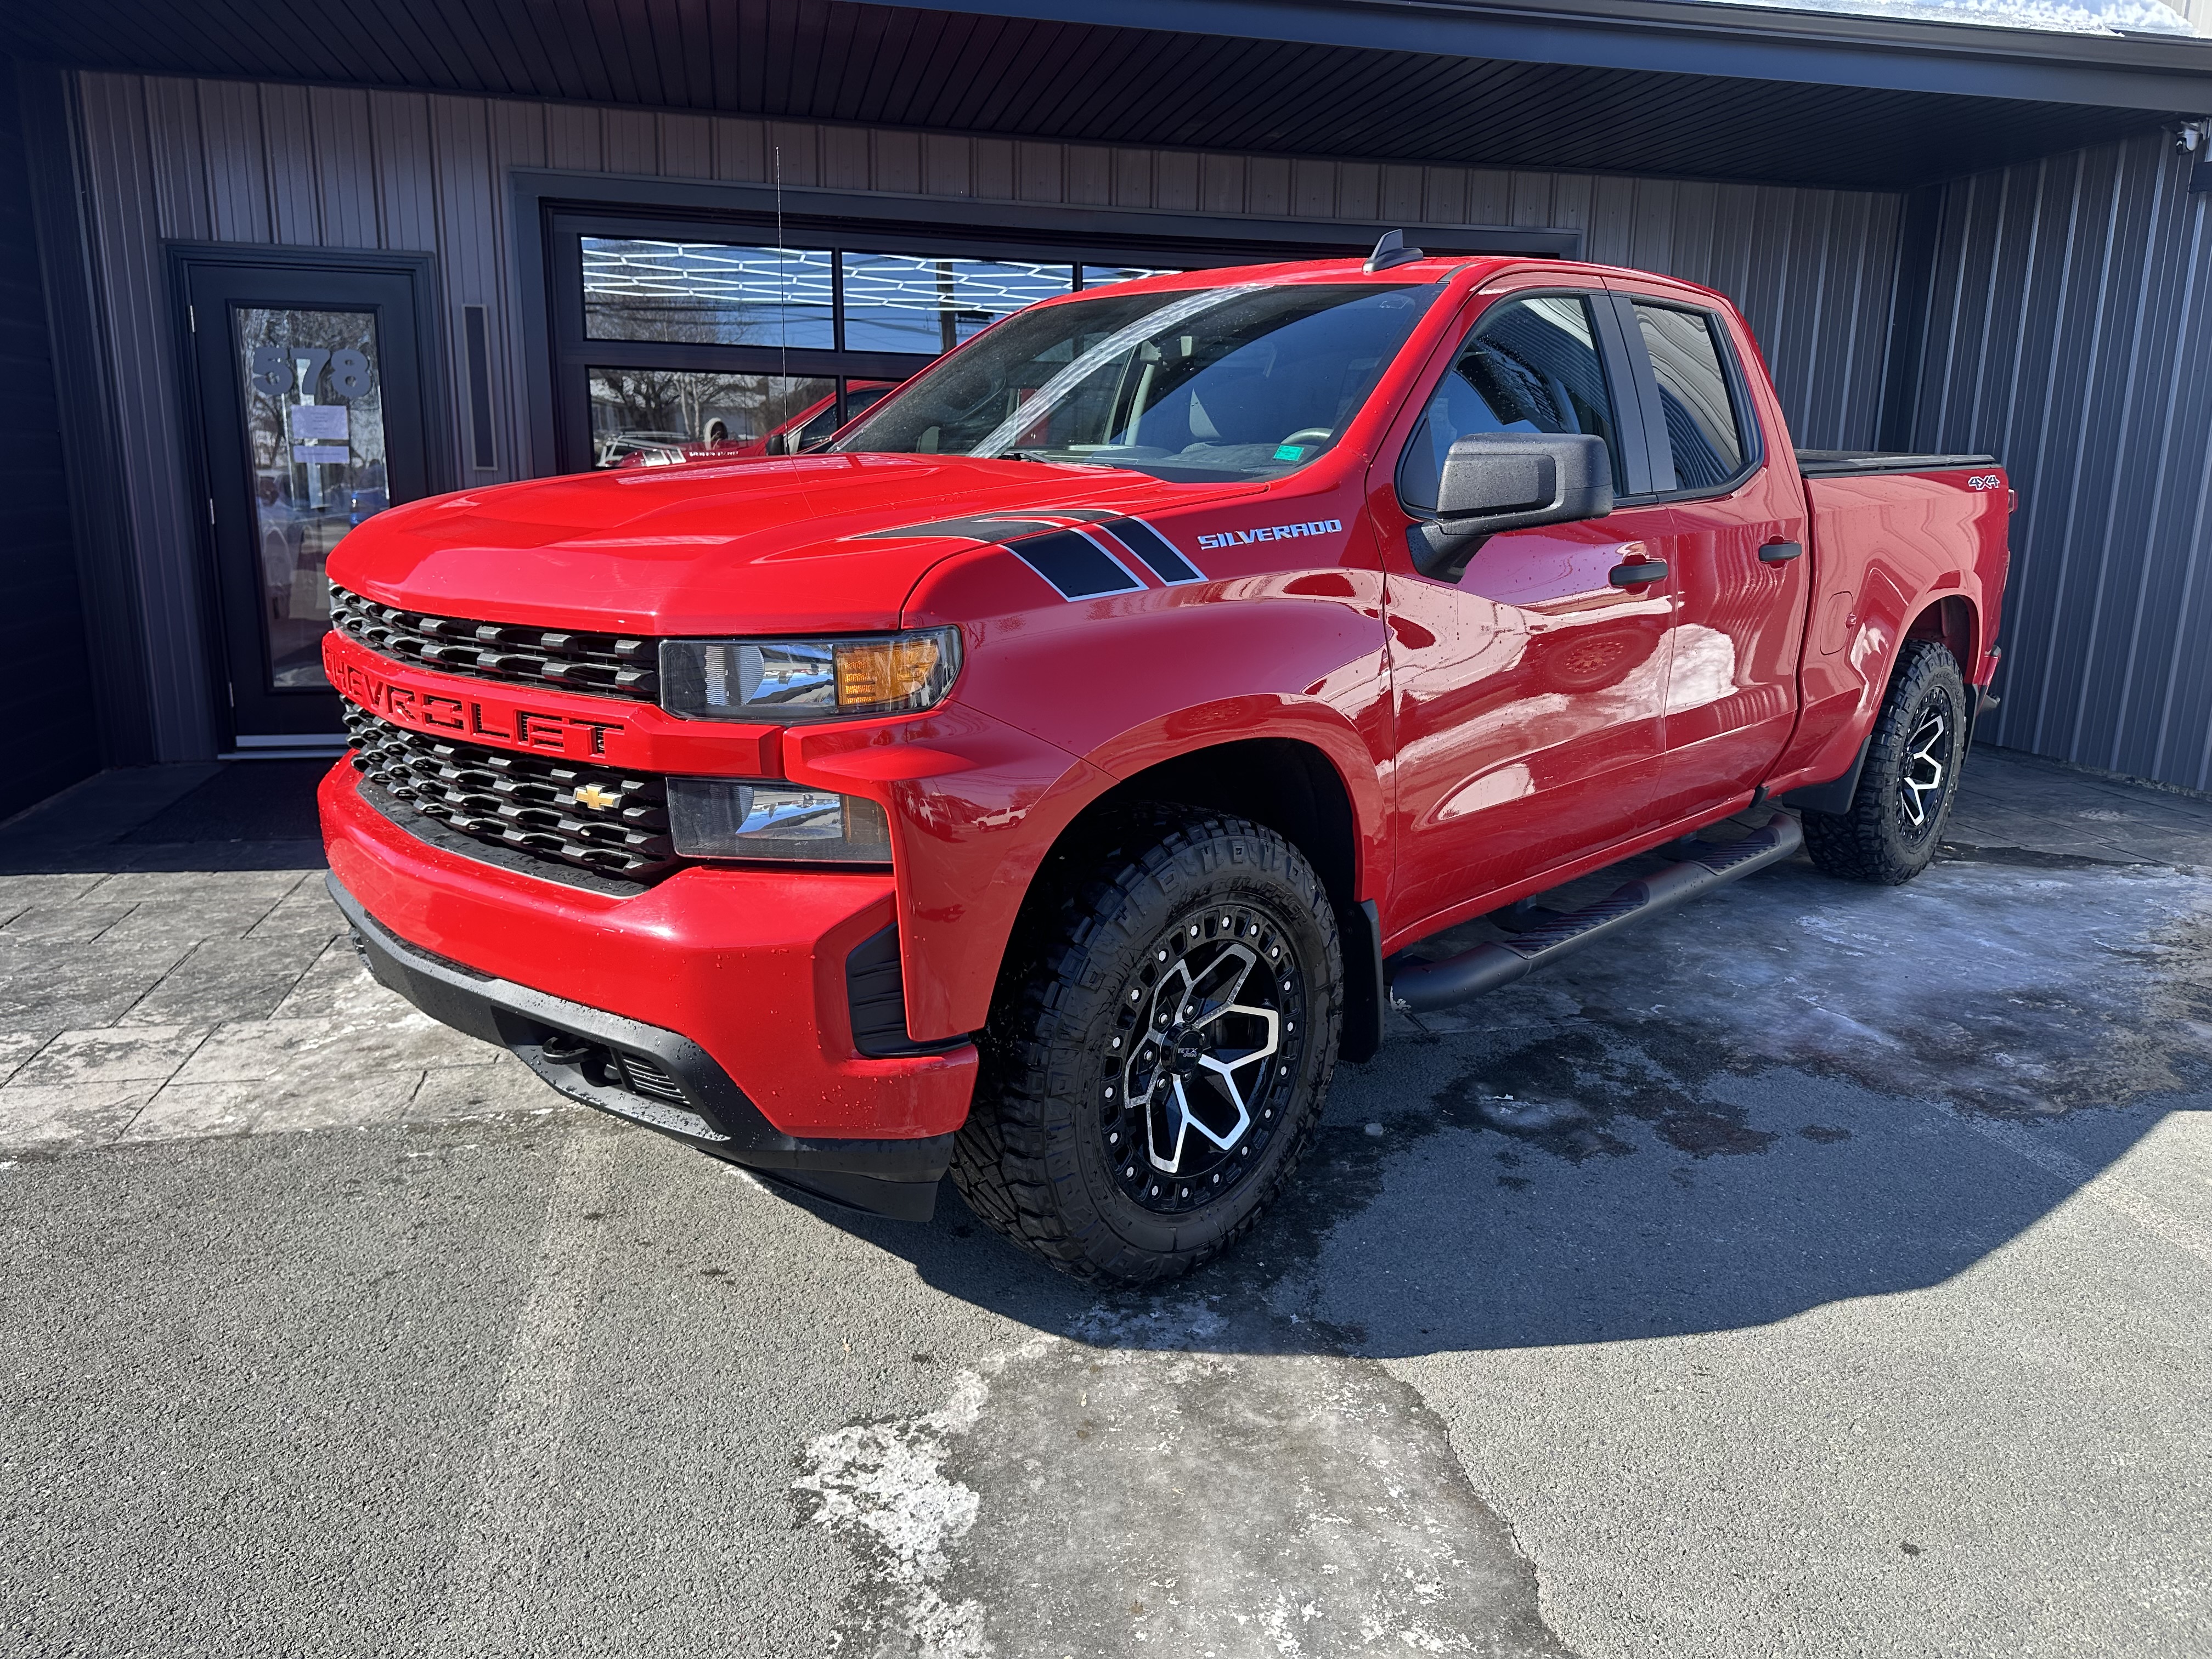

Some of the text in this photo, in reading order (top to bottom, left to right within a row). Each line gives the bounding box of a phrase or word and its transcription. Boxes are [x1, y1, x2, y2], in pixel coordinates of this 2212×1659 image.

[252, 347, 371, 398] 578
[1197, 519, 1342, 550] SILVERADO
[323, 645, 626, 759] CHEVROLET
